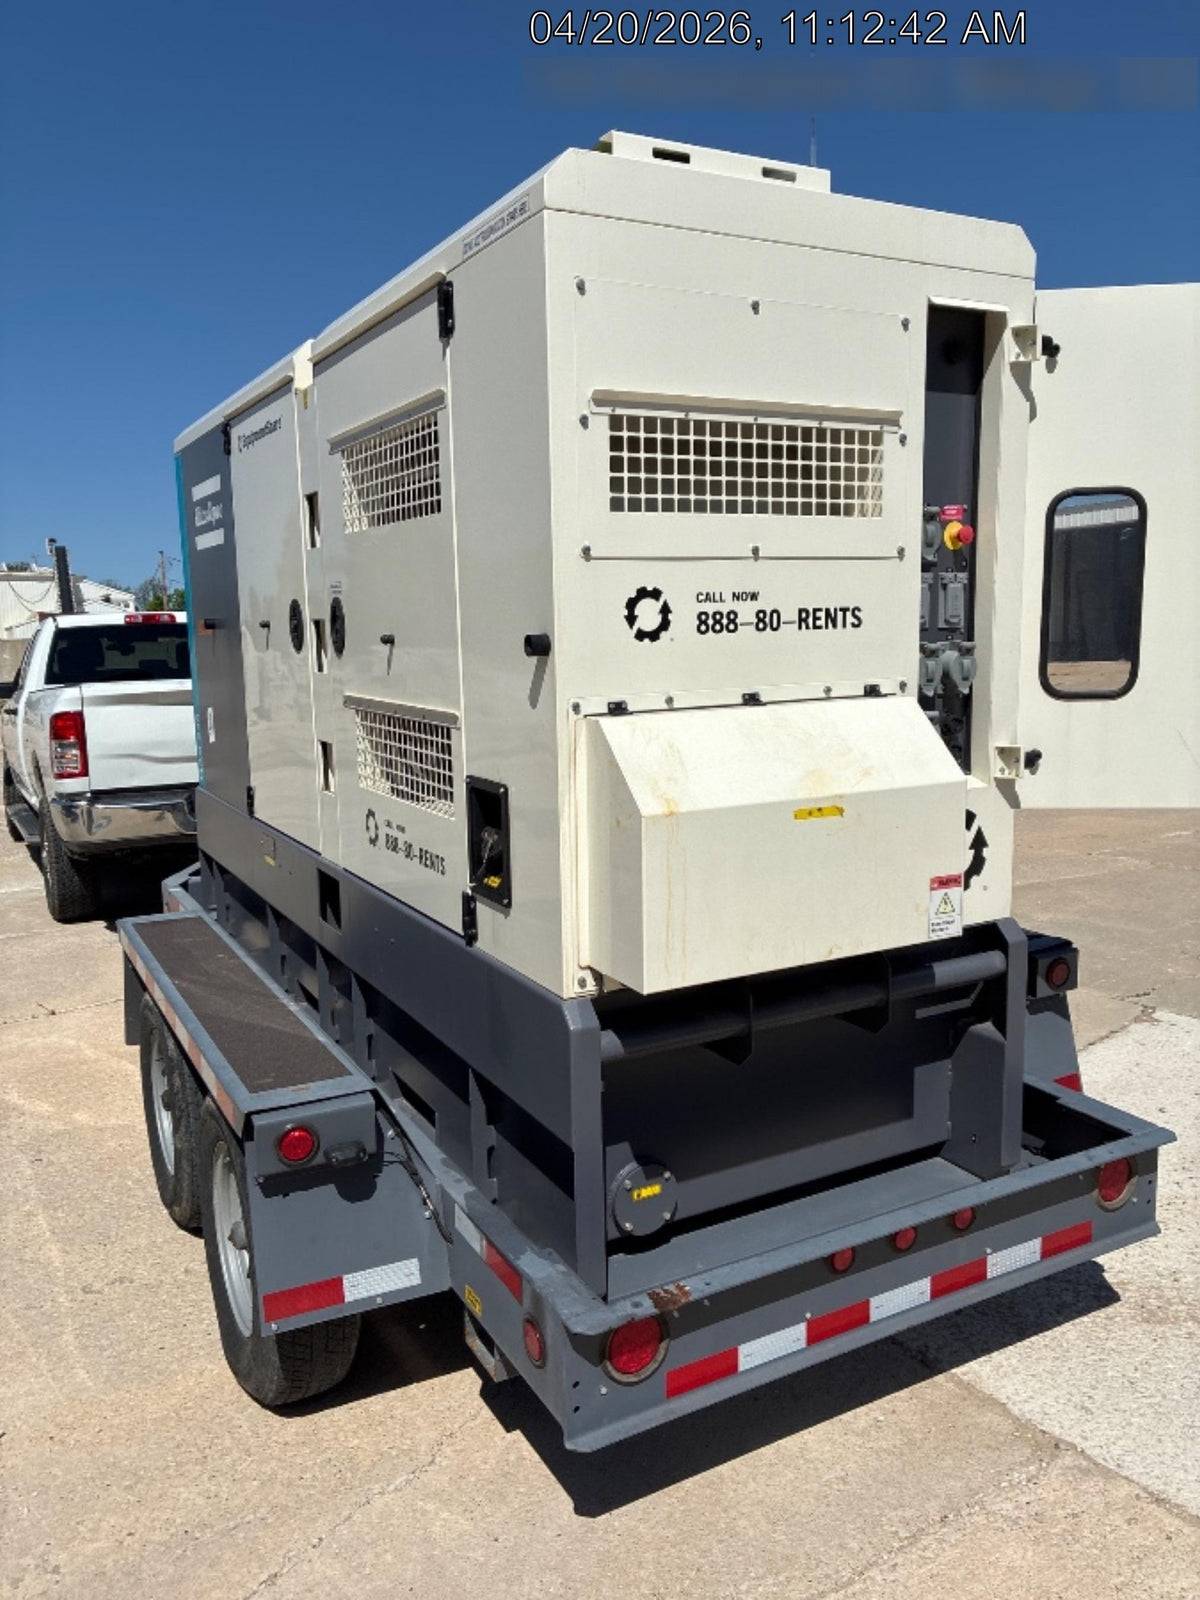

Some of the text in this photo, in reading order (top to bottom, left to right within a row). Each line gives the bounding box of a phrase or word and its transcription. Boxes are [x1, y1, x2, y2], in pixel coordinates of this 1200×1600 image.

[696, 590, 760, 604] CALL NOW
[696, 606, 863, 635] 888-80-RENTS
